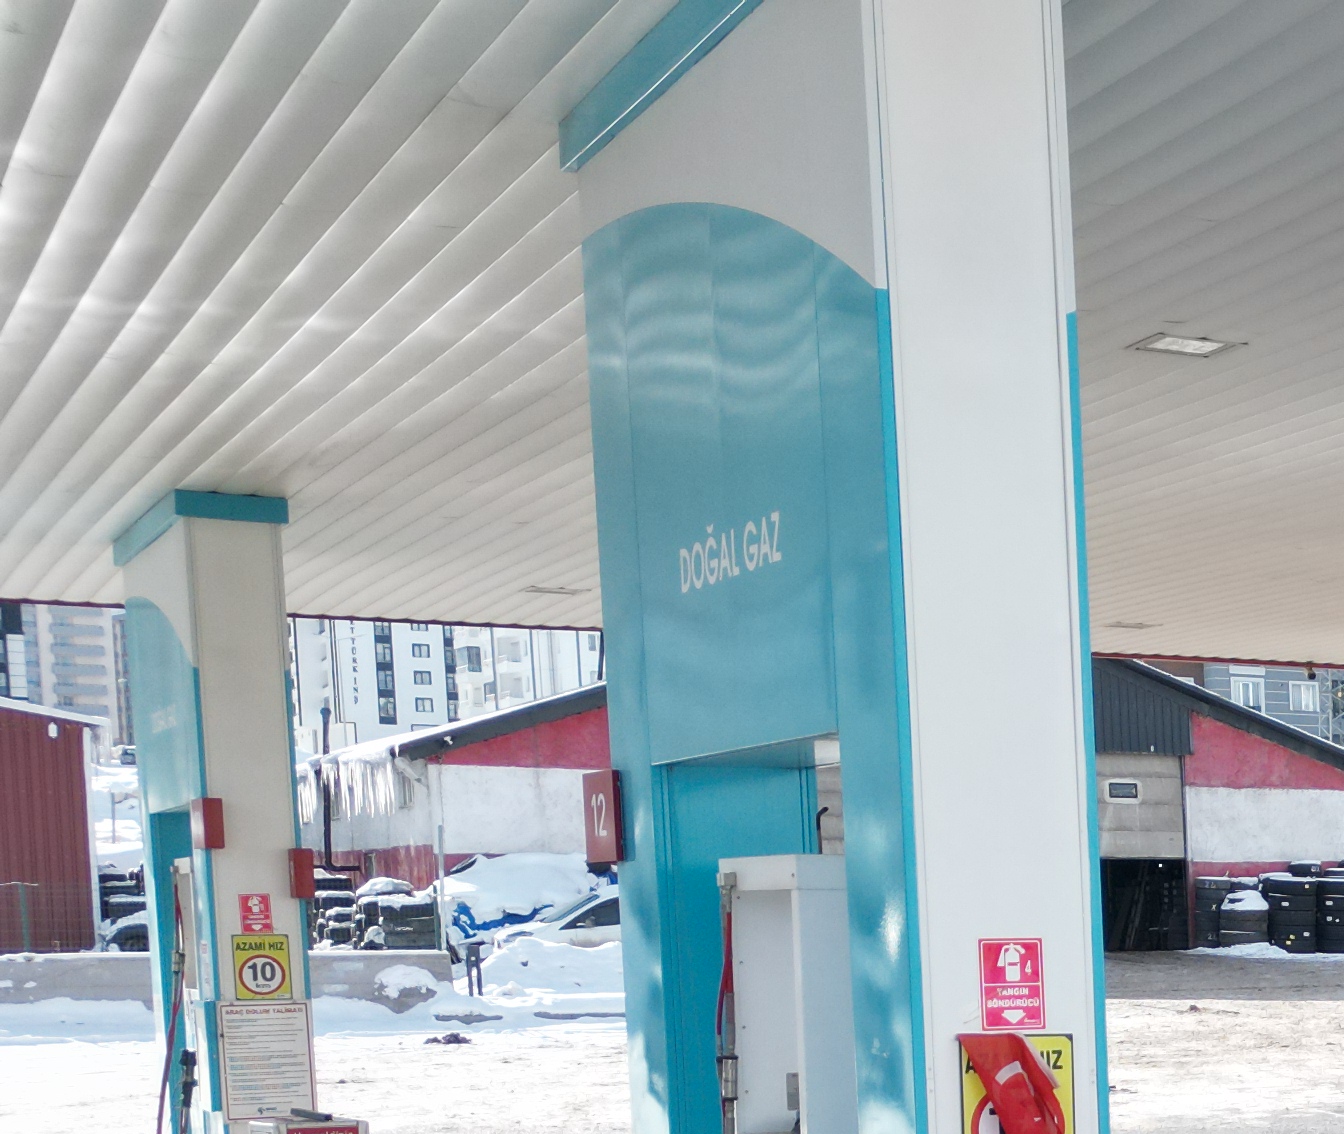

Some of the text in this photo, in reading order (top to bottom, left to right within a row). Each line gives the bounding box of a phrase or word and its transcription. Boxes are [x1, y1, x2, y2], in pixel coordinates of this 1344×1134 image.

[680, 510, 782, 593] DOĞAL GAZ
[591, 793, 607, 837] 12
[247, 961, 277, 982] 10
